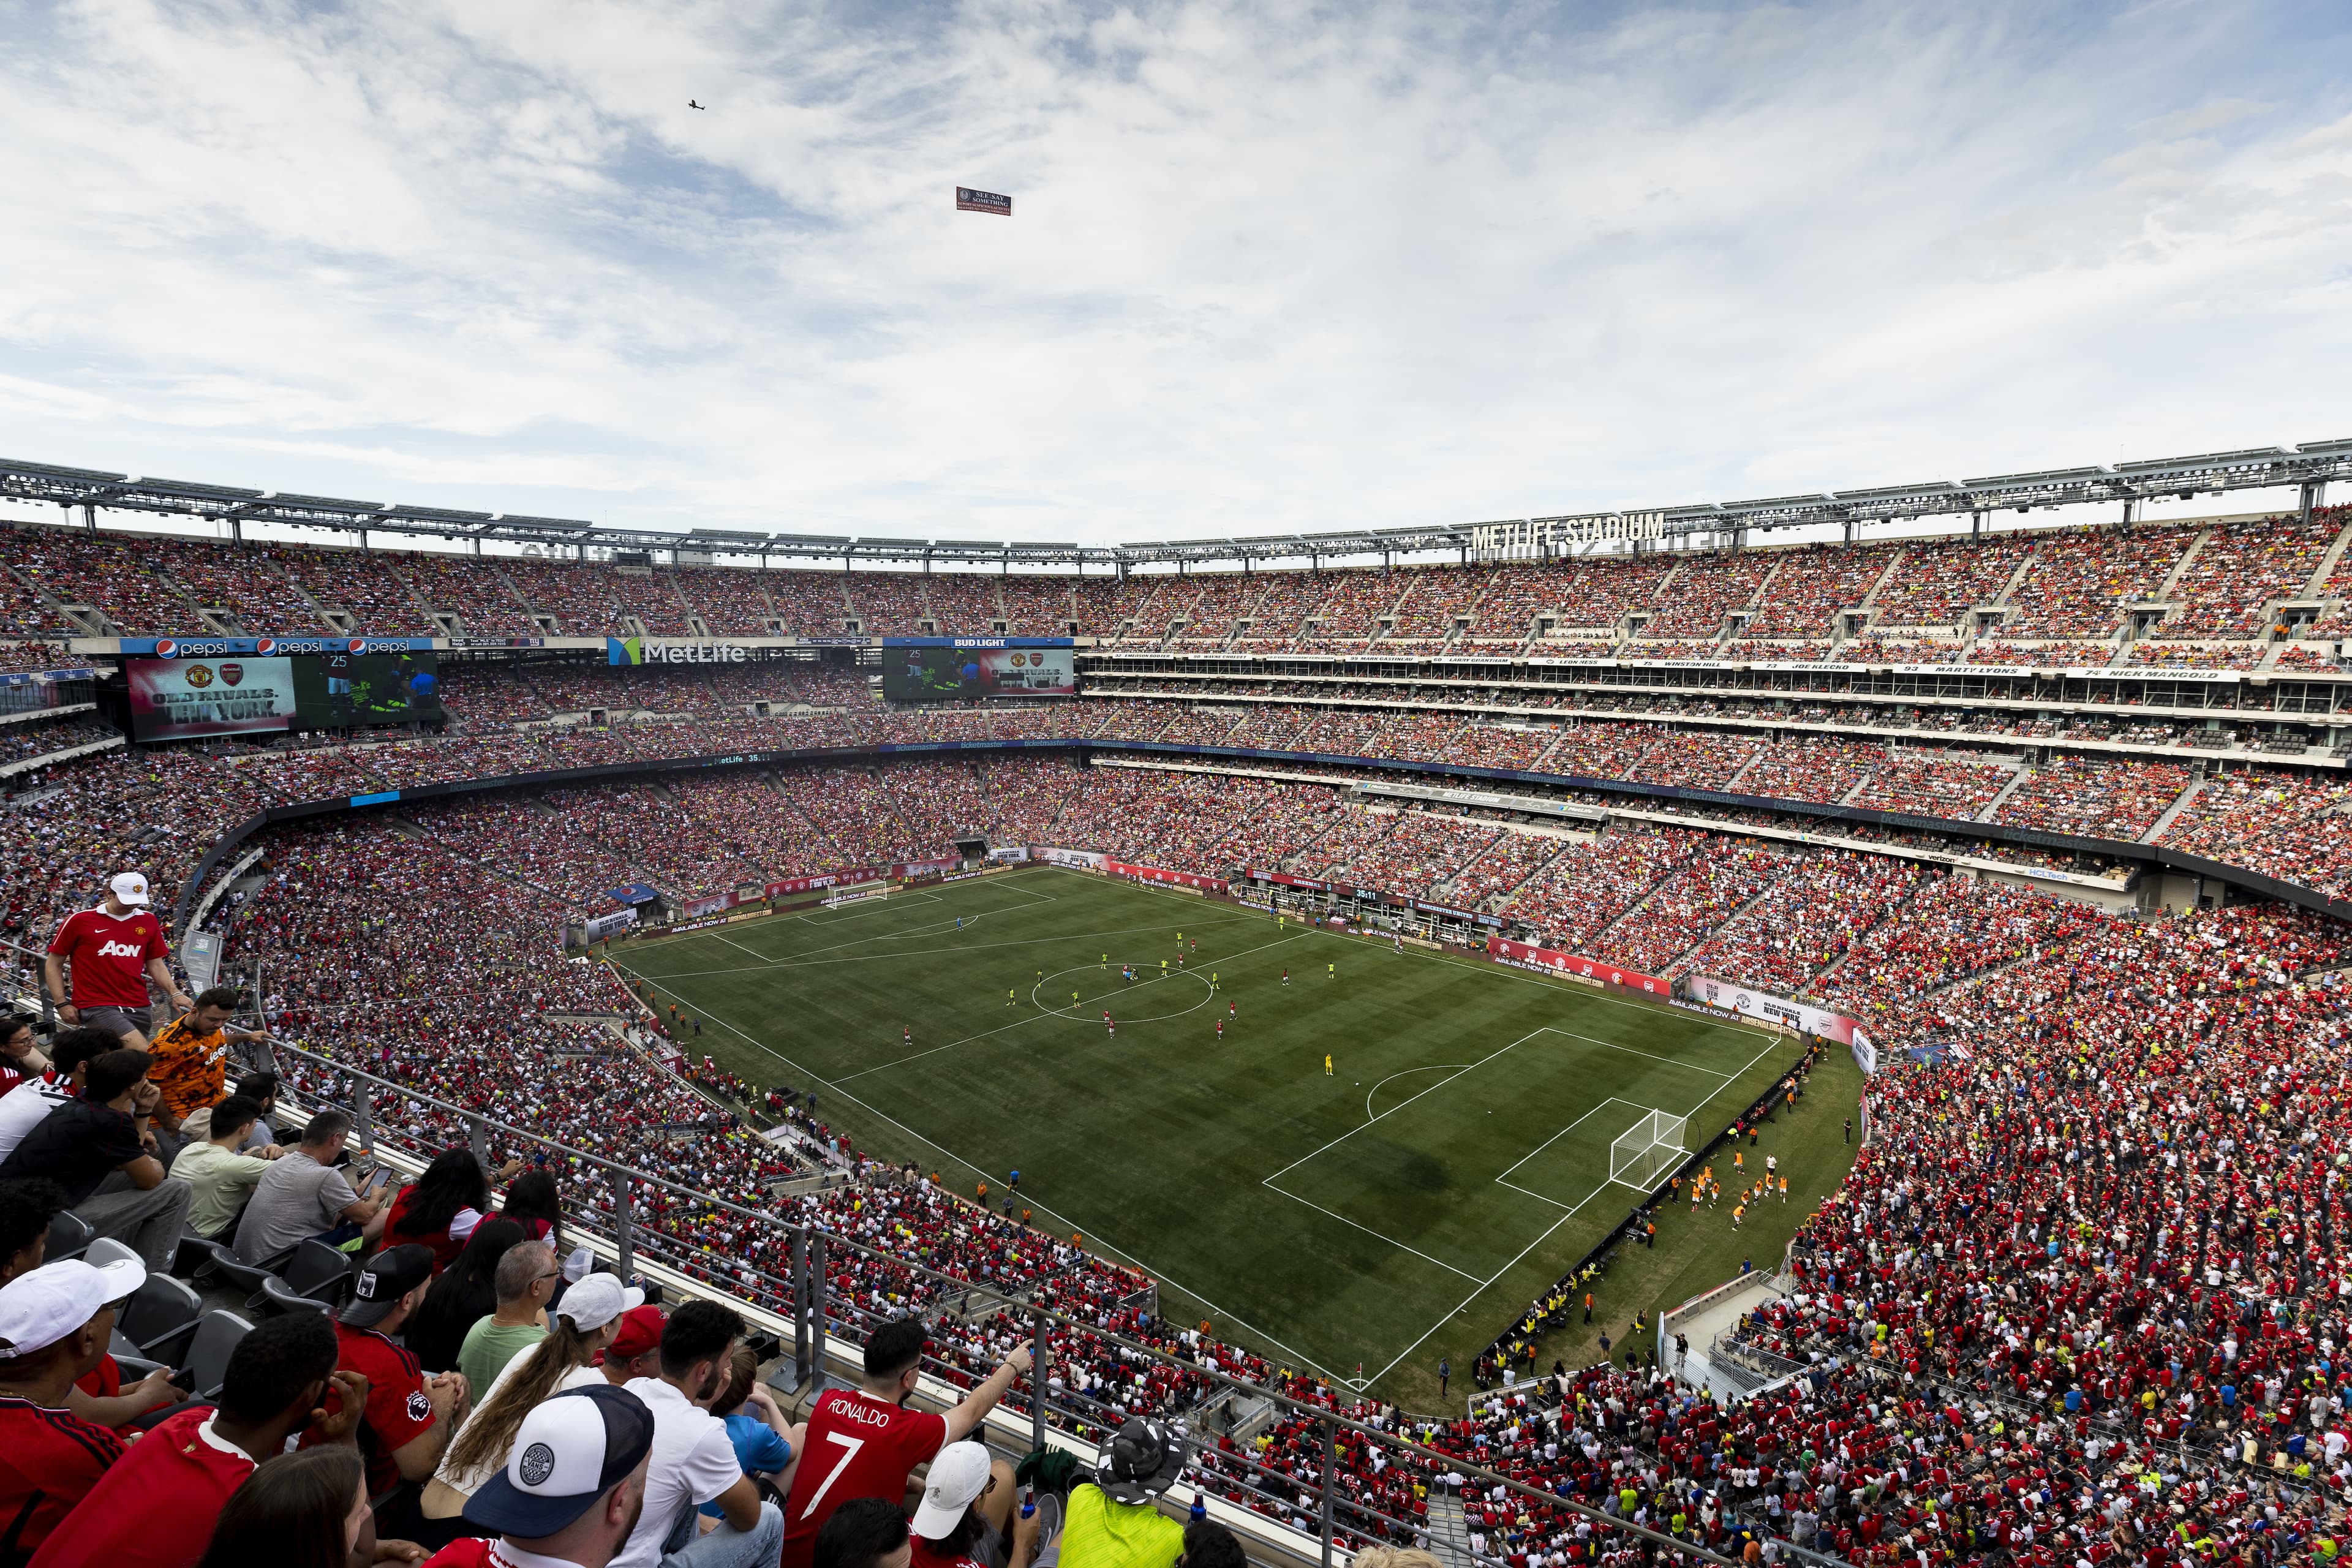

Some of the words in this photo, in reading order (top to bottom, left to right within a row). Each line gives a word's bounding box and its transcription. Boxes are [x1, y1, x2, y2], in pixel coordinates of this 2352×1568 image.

[973, 197, 1008, 207] SOMETHING
[1472, 521, 1559, 551] METLIFE
[1564, 513, 1665, 545] STADIUM
[181, 641, 228, 657] pepsi
[278, 640, 323, 654] pepsi
[368, 640, 409, 654] pepsi
[644, 641, 745, 663] MetLife
[909, 650, 921, 658] 25
[330, 655, 347, 667] 25
[2145, 671, 2218, 679] MANGOLD
[153, 693, 194, 704] OLD
[198, 688, 279, 702] RIVALS.
[216, 700, 281, 721] YORK.
[714, 755, 744, 764] MetLife
[1257, 750, 1298, 759] ticketmaster
[1316, 755, 1360, 764] ticketmaster
[1378, 760, 1425, 769] ticketmaster
[1446, 765, 1494, 776] ticketmaster
[1517, 772, 1570, 784] ticketmaster
[450, 778, 509, 793] ticketmaster
[1594, 780, 1653, 794] ticketmaster
[1470, 794, 1501, 802] STADIUM
[1679, 789, 1744, 804] ticketmaster
[2030, 869, 2068, 881] HCLTech
[1294, 879, 1321, 888] ARSENAL
[1357, 889, 1376, 900] 35:11
[1239, 900, 1261, 909] AVAILABLE
[1418, 903, 1453, 914] MANCHESTER
[1453, 910, 1473, 919] UNITED
[672, 922, 704, 933] AVAILABLE
[728, 909, 772, 922] ARSENALDIRECT.COM
[600, 924, 613, 933] NEW
[1400, 935, 1442, 950] ARSENALDIRECT.COM
[1494, 957, 1526, 969] AVAILABLE
[1528, 964, 1543, 973] NOW
[1552, 970, 1604, 989] ARSENALDIRECT.COM
[1764, 1006, 1780, 1017] NEW
[1778, 1005, 1802, 1016] RIVALS.
[1668, 999, 1708, 1013] AVAILABLE
[1709, 1008, 1728, 1018] NOW
[1741, 1016, 1801, 1041] ARSENALDIRECT.COM
[828, 1398, 890, 1428] RONALDO
[527, 1458, 544, 1470] VANS
[800, 1431, 865, 1521] 7
[1402, 1494, 1406, 1504] 7
[1475, 1540, 1483, 1549] 10
